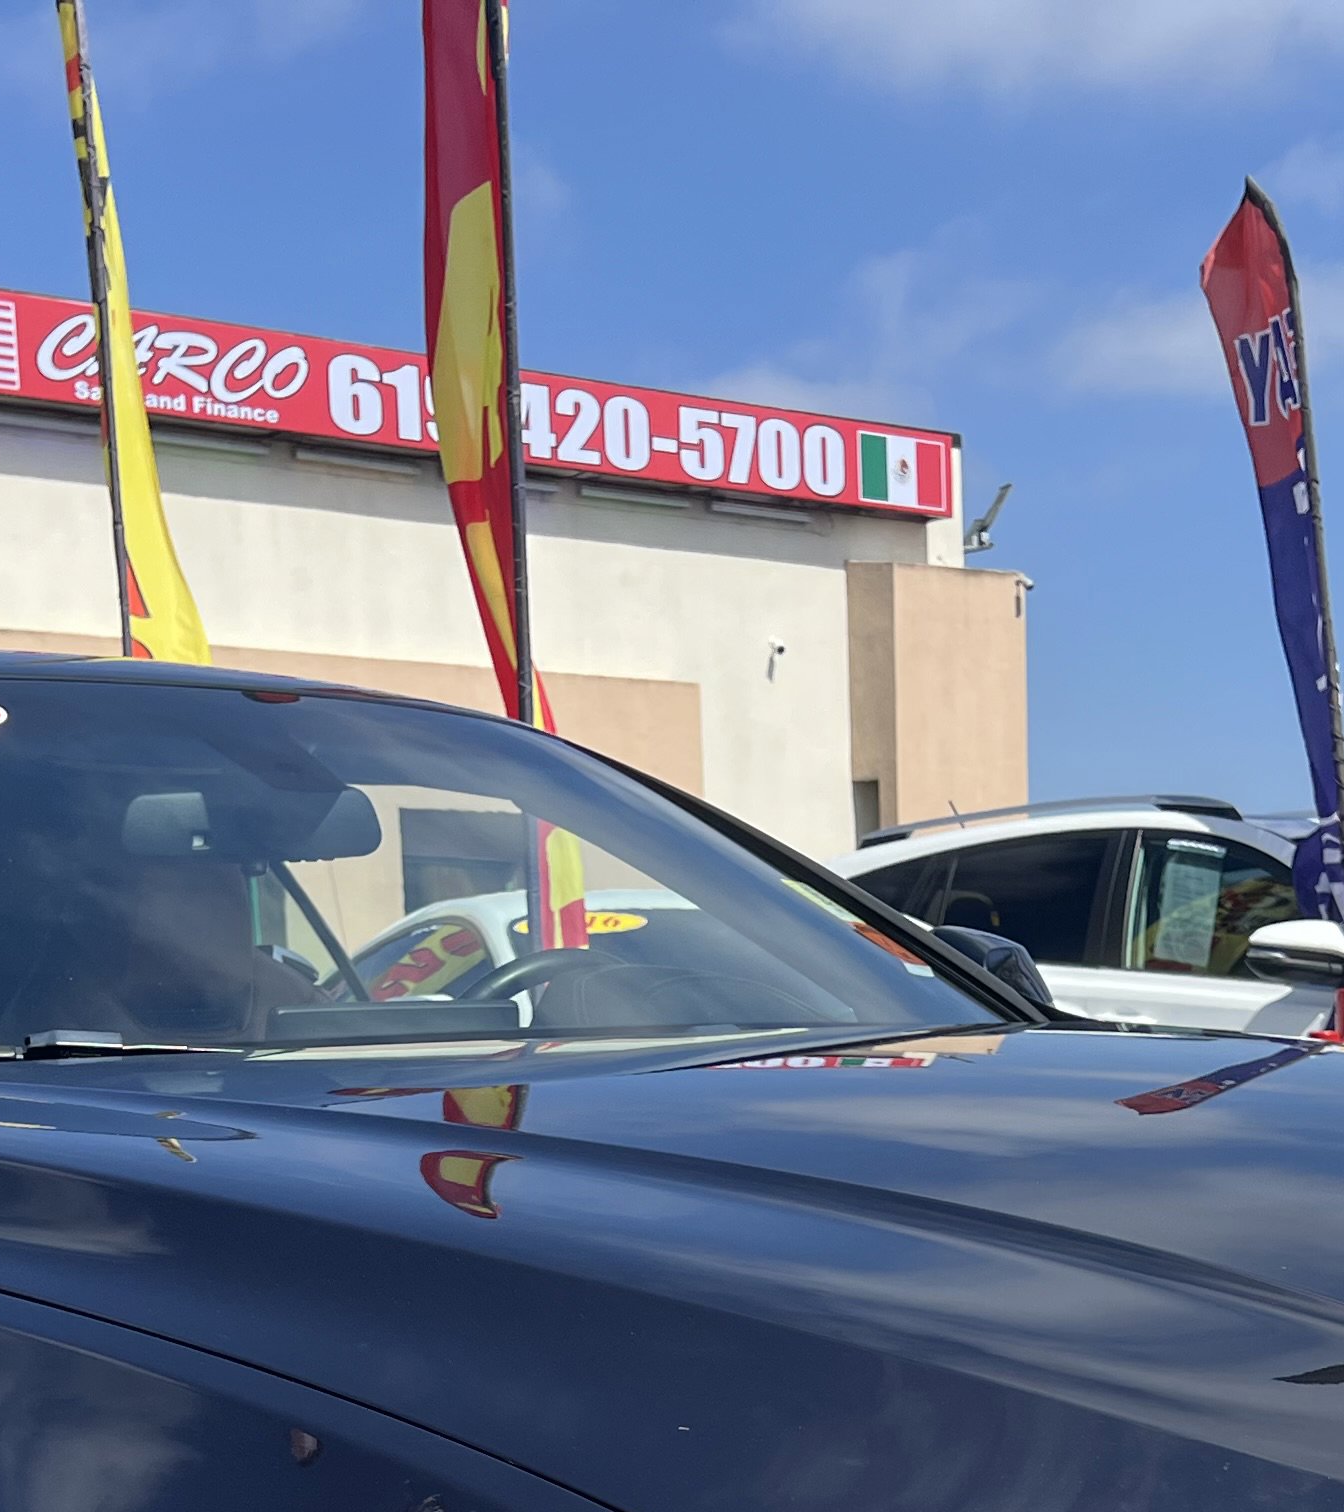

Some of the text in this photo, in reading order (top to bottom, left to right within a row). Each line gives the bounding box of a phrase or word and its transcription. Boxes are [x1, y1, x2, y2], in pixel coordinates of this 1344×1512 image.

[145, 393, 280, 424] and Finance
[327, 353, 440, 442] 61
